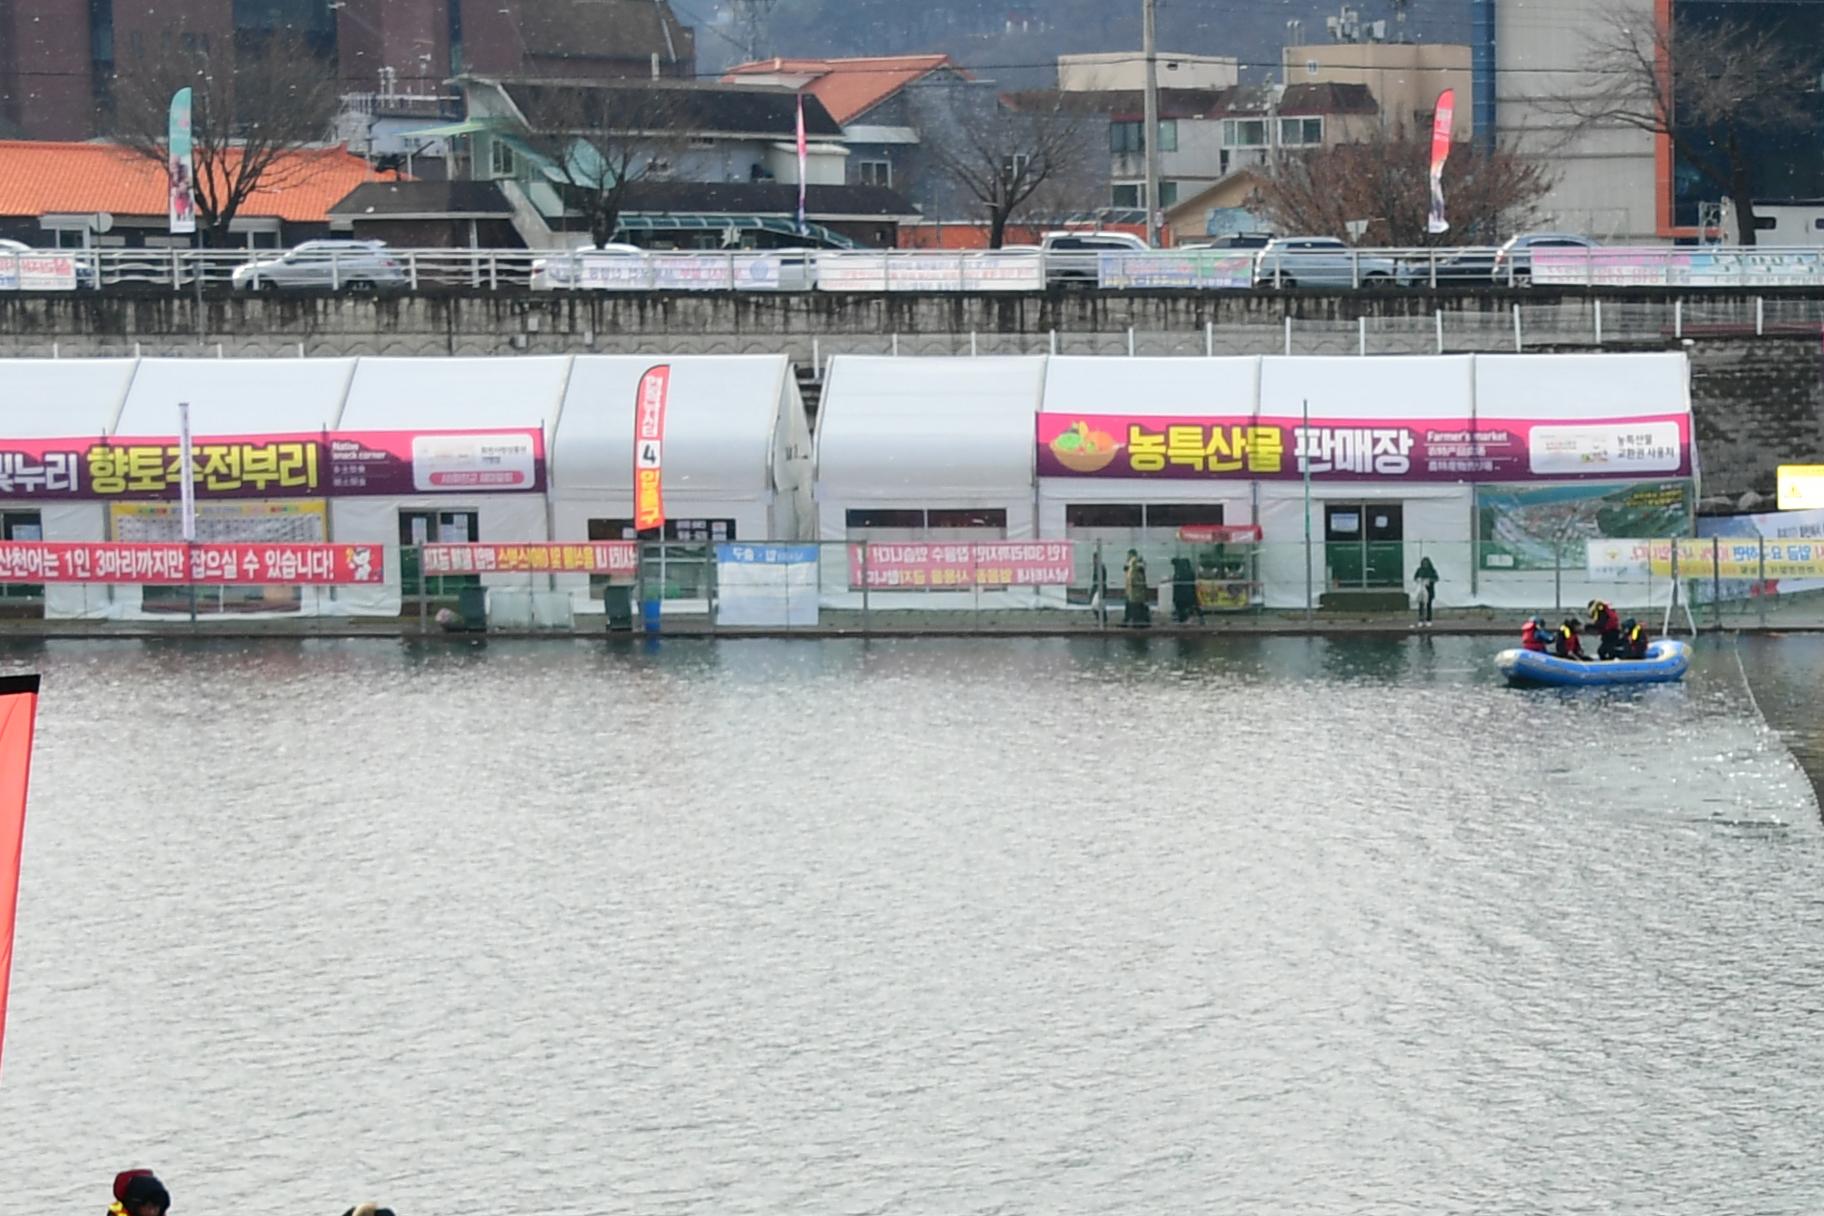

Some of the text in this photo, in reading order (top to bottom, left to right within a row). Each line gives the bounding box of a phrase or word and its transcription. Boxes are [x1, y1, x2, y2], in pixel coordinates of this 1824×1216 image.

[1128, 425, 1414, 474] 농특산물 판매장
[1427, 431, 1508, 443] Farmer's market
[64, 549, 91, 578] 1인
[96, 548, 184, 579] 3마리까지만
[191, 549, 237, 580] 잡으실
[243, 549, 260, 578] 수
[265, 548, 334, 580] 있습니다!
